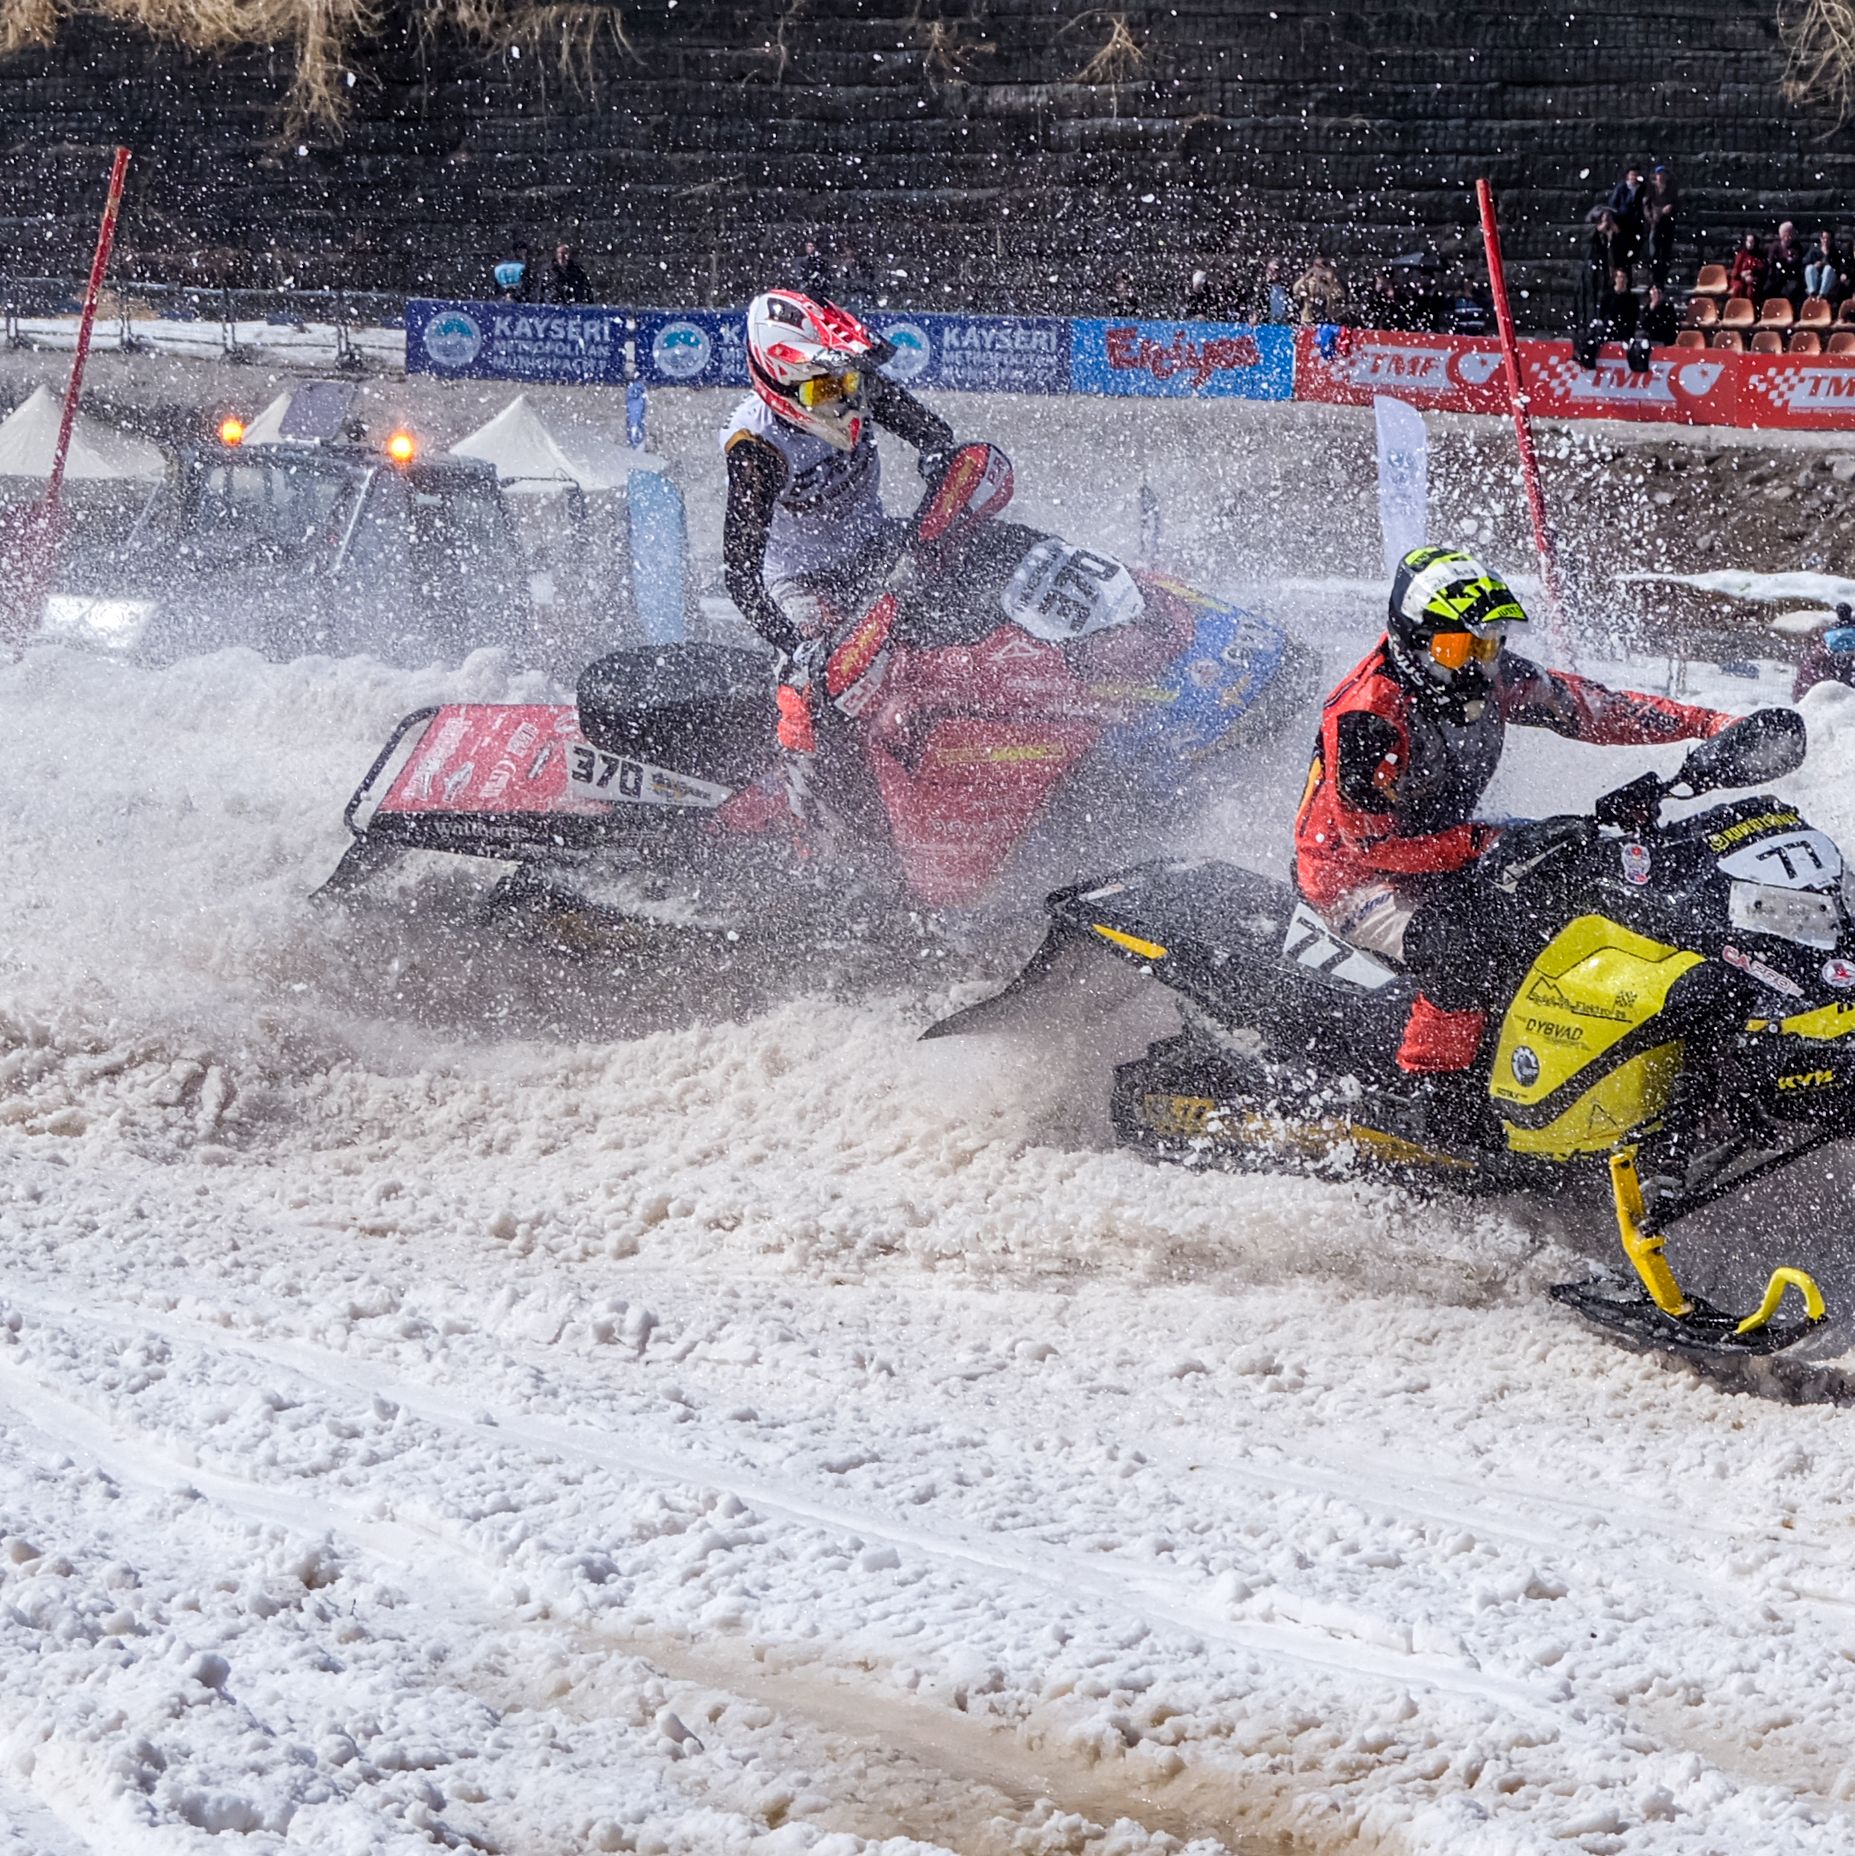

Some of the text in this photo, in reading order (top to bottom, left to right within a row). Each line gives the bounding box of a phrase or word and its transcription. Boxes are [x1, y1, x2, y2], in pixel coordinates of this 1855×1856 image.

[1368, 352, 1439, 377] TMF
[1591, 365, 1663, 389] TMF
[1036, 548, 1121, 634] 370
[569, 744, 645, 799] 370
[1755, 838, 1823, 881] 77
[1286, 915, 1355, 975] 77
[1524, 1017, 1584, 1041] DYBVAD
